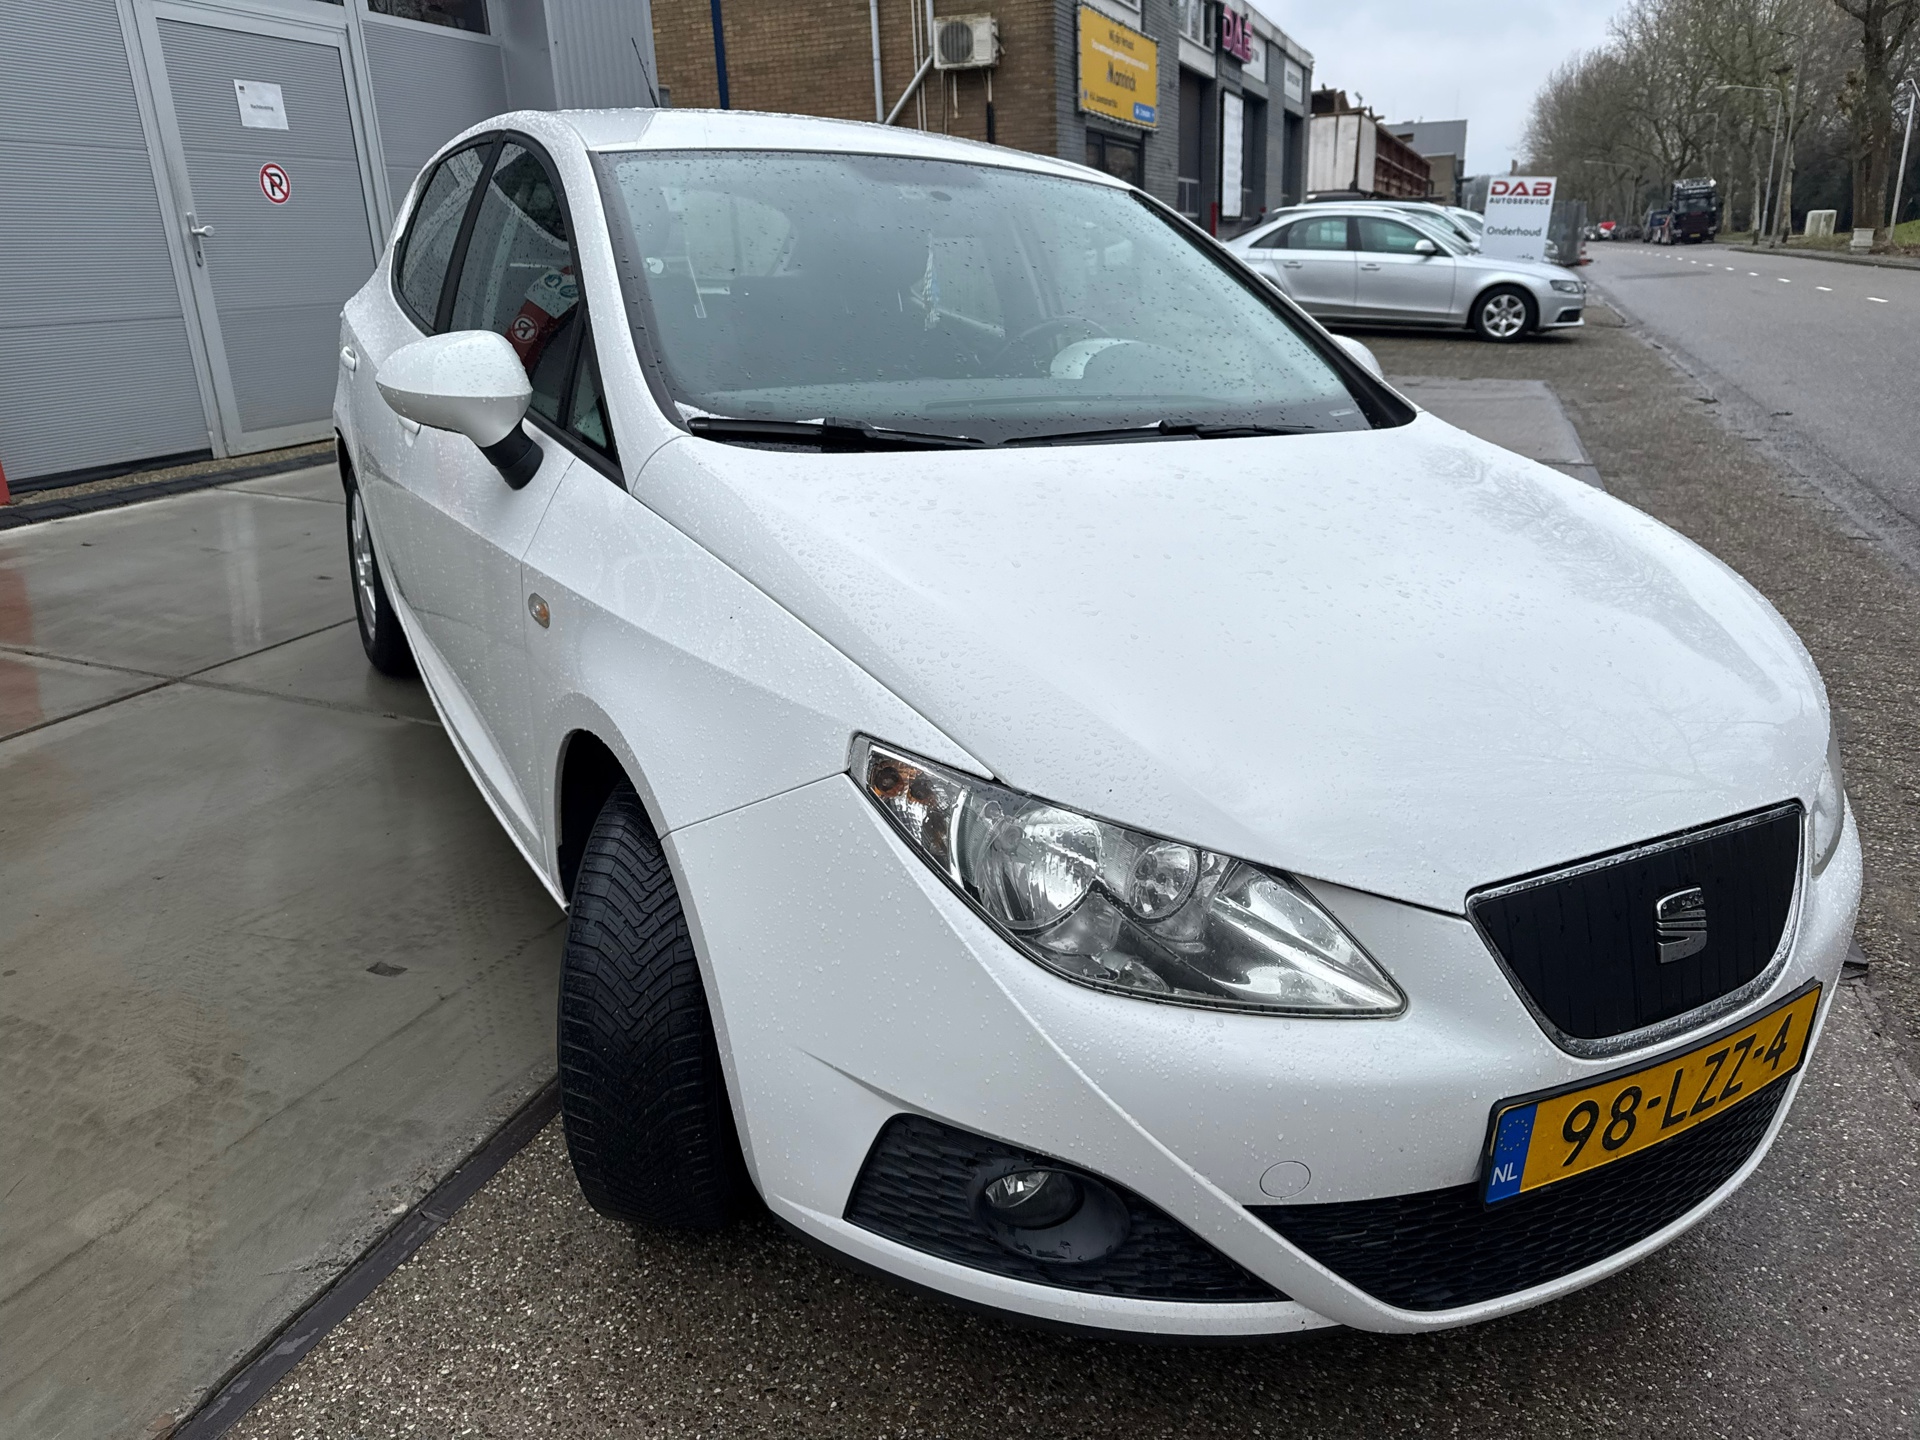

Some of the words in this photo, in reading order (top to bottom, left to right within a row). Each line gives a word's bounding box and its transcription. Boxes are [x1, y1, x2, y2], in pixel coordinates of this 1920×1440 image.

[1490, 181, 1552, 196] DAB
[1489, 197, 1550, 205] AUTOSERVICE
[1486, 226, 1542, 237] Onderhoud
[1562, 1013, 1793, 1167] 98-LZZ-4
[1491, 1162, 1518, 1186] NL
